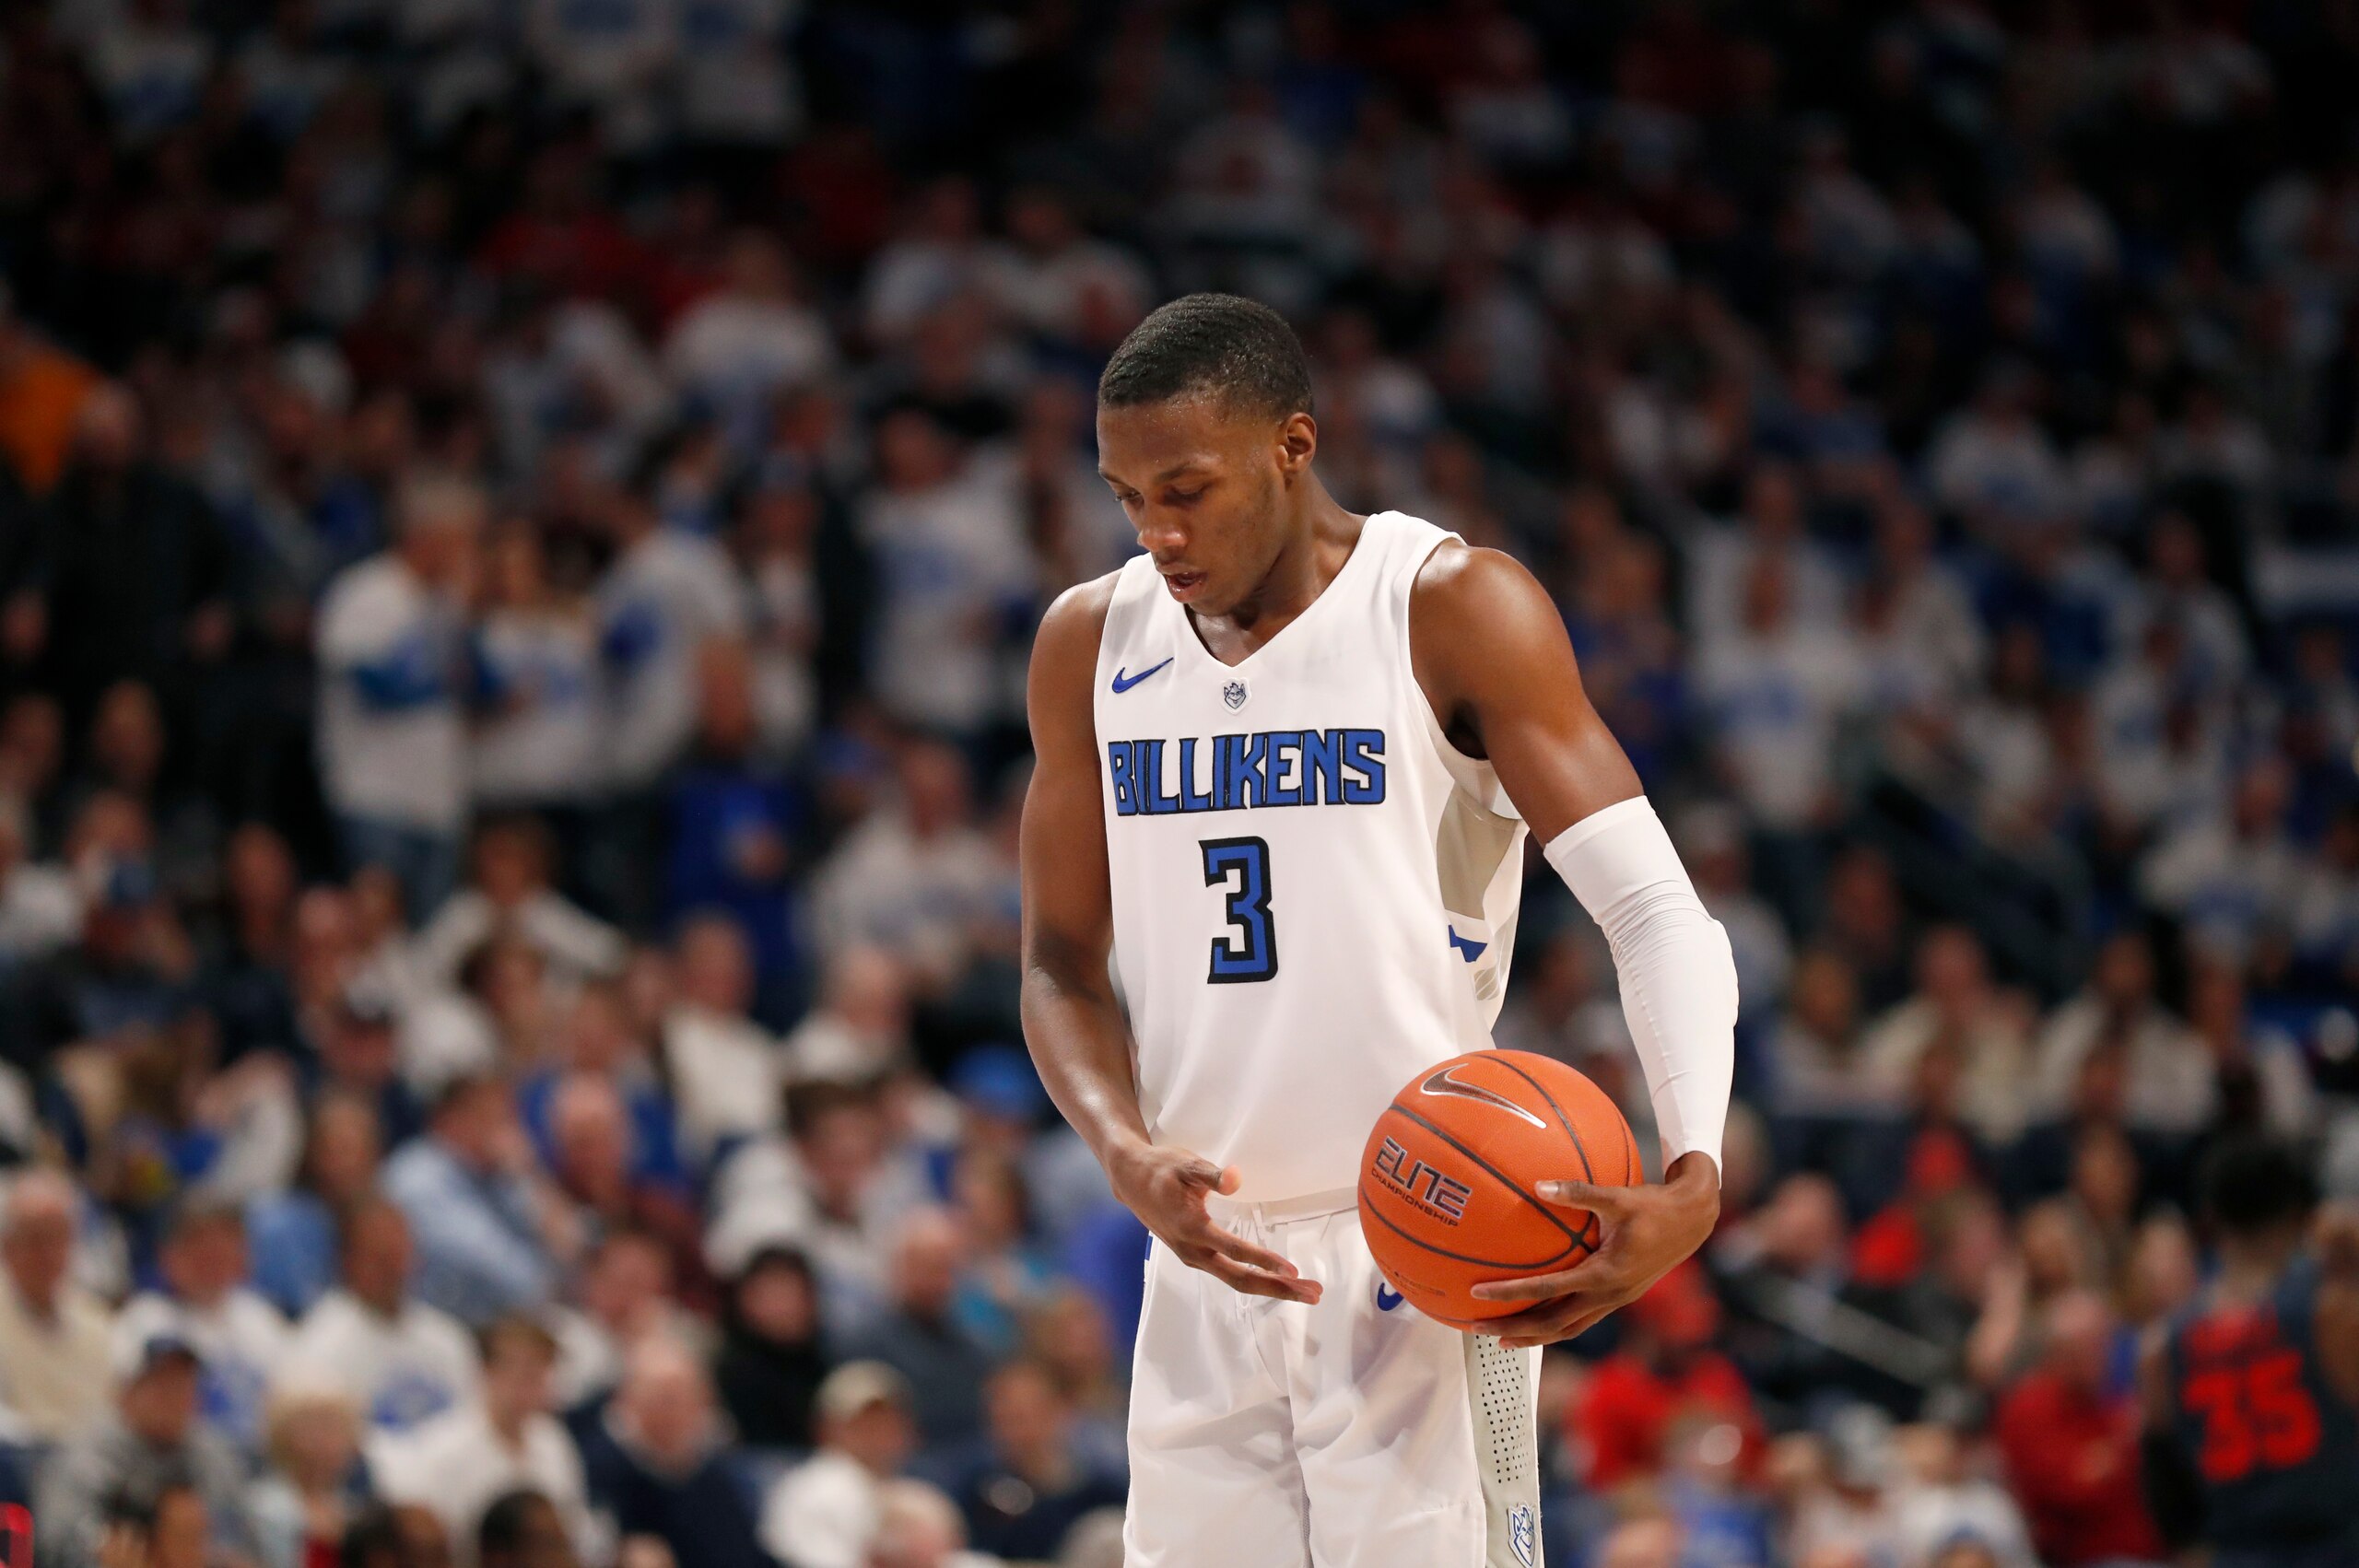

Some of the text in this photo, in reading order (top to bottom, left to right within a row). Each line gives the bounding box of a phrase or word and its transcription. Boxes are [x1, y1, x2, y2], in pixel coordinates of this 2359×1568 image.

[1109, 729, 1386, 816] BILLIKENS
[1198, 836, 1279, 985] 3
[1370, 1168, 1460, 1228] CHAMPIONSHIP
[1374, 1135, 1472, 1220] ELITE
[2180, 1349, 2322, 1482] 35
